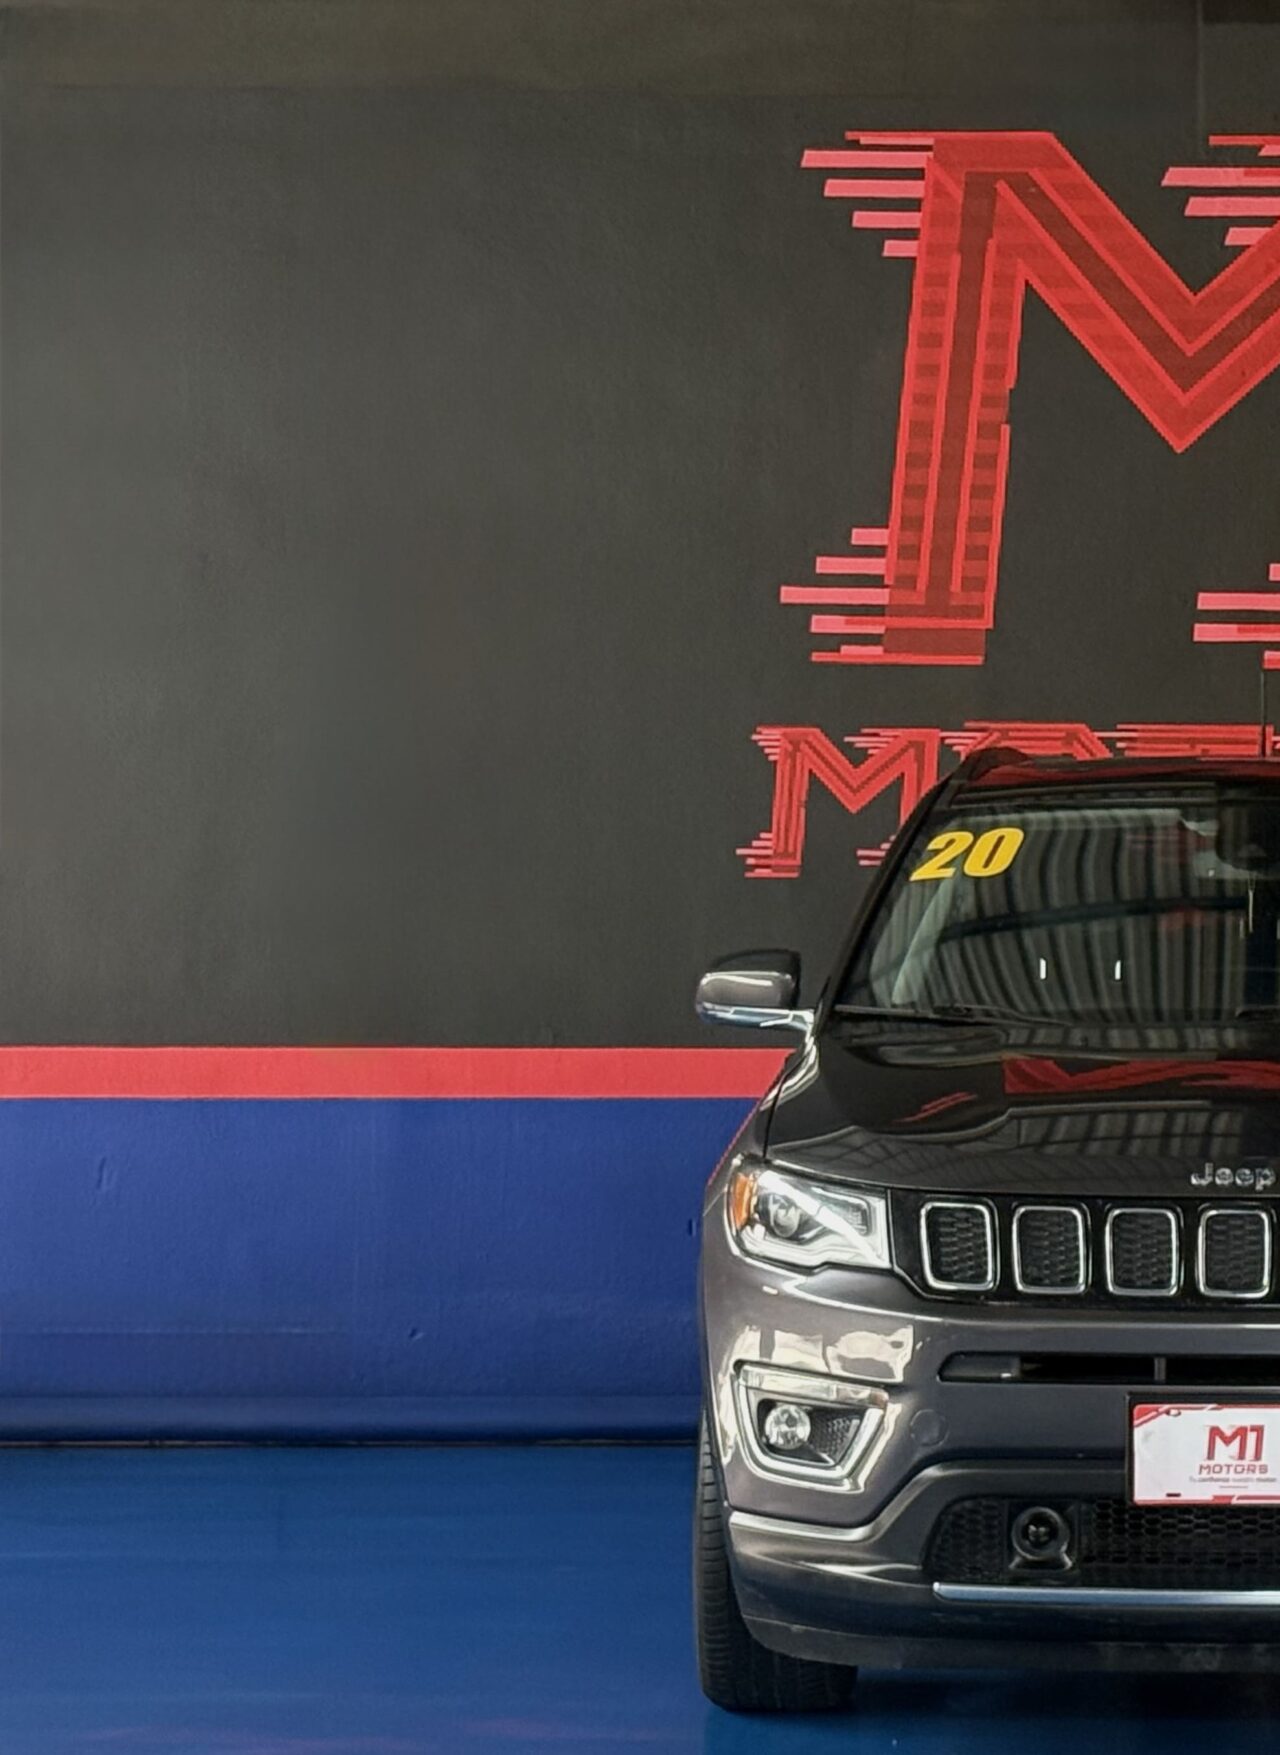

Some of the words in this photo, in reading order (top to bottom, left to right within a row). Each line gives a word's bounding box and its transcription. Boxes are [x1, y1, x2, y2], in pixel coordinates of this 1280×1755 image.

[910, 828, 1025, 881] 20
[1190, 1162, 1276, 1191] Jeep
[1204, 1424, 1265, 1462] M1
[1198, 1463, 1269, 1475] MOTORS
